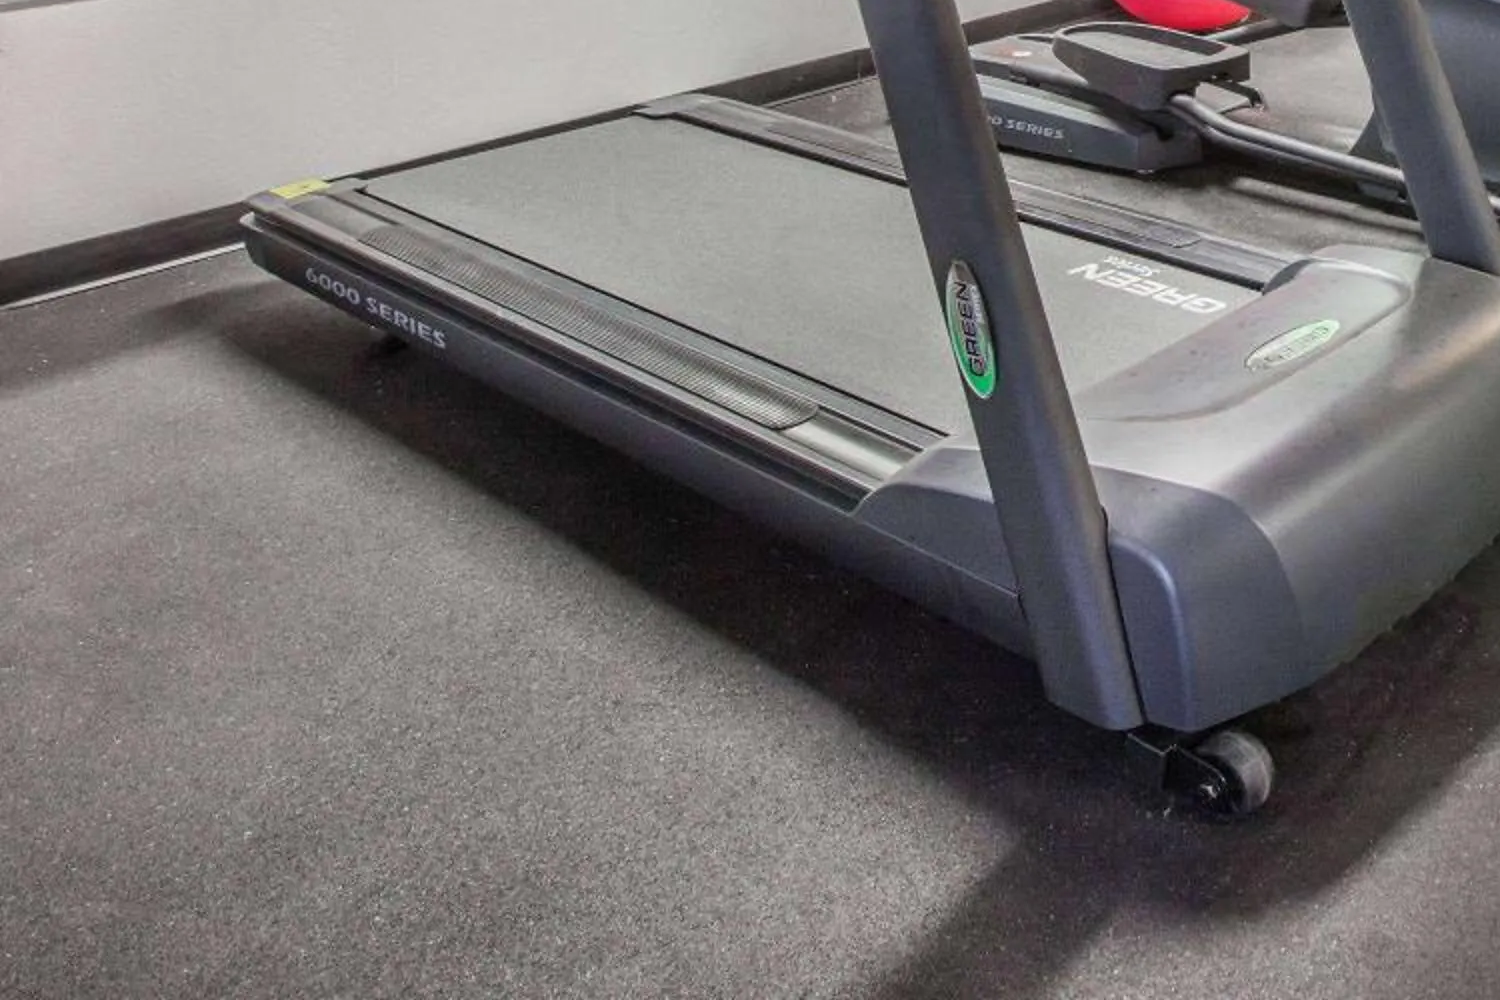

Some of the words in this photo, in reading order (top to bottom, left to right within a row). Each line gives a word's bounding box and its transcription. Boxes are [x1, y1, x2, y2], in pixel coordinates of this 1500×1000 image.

[305, 267, 361, 305] 6000
[365, 297, 446, 349] SERIES
[954, 281, 985, 377] GREEN
[1067, 263, 1227, 314] GREEN
